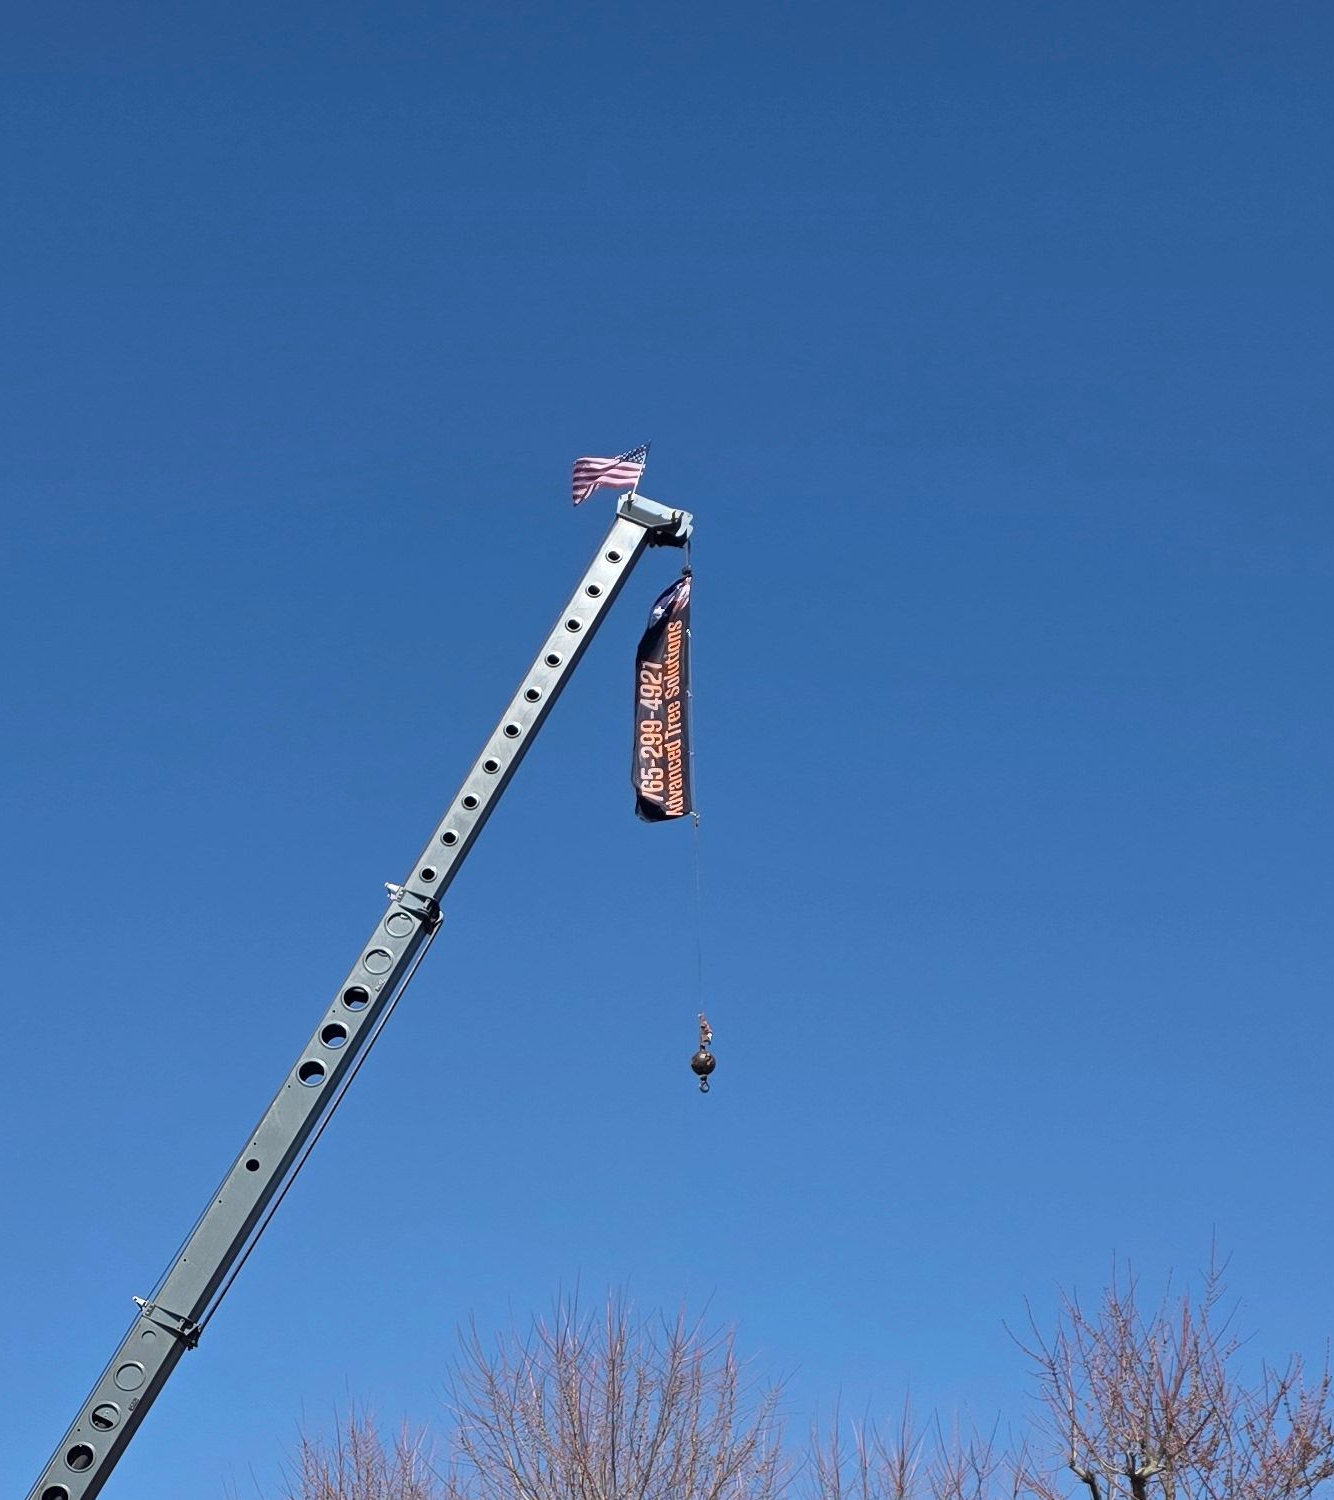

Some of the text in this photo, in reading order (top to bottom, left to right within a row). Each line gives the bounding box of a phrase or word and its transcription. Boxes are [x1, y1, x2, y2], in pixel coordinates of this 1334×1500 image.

[664, 620, 683, 815] Advanced Tree Solutions
